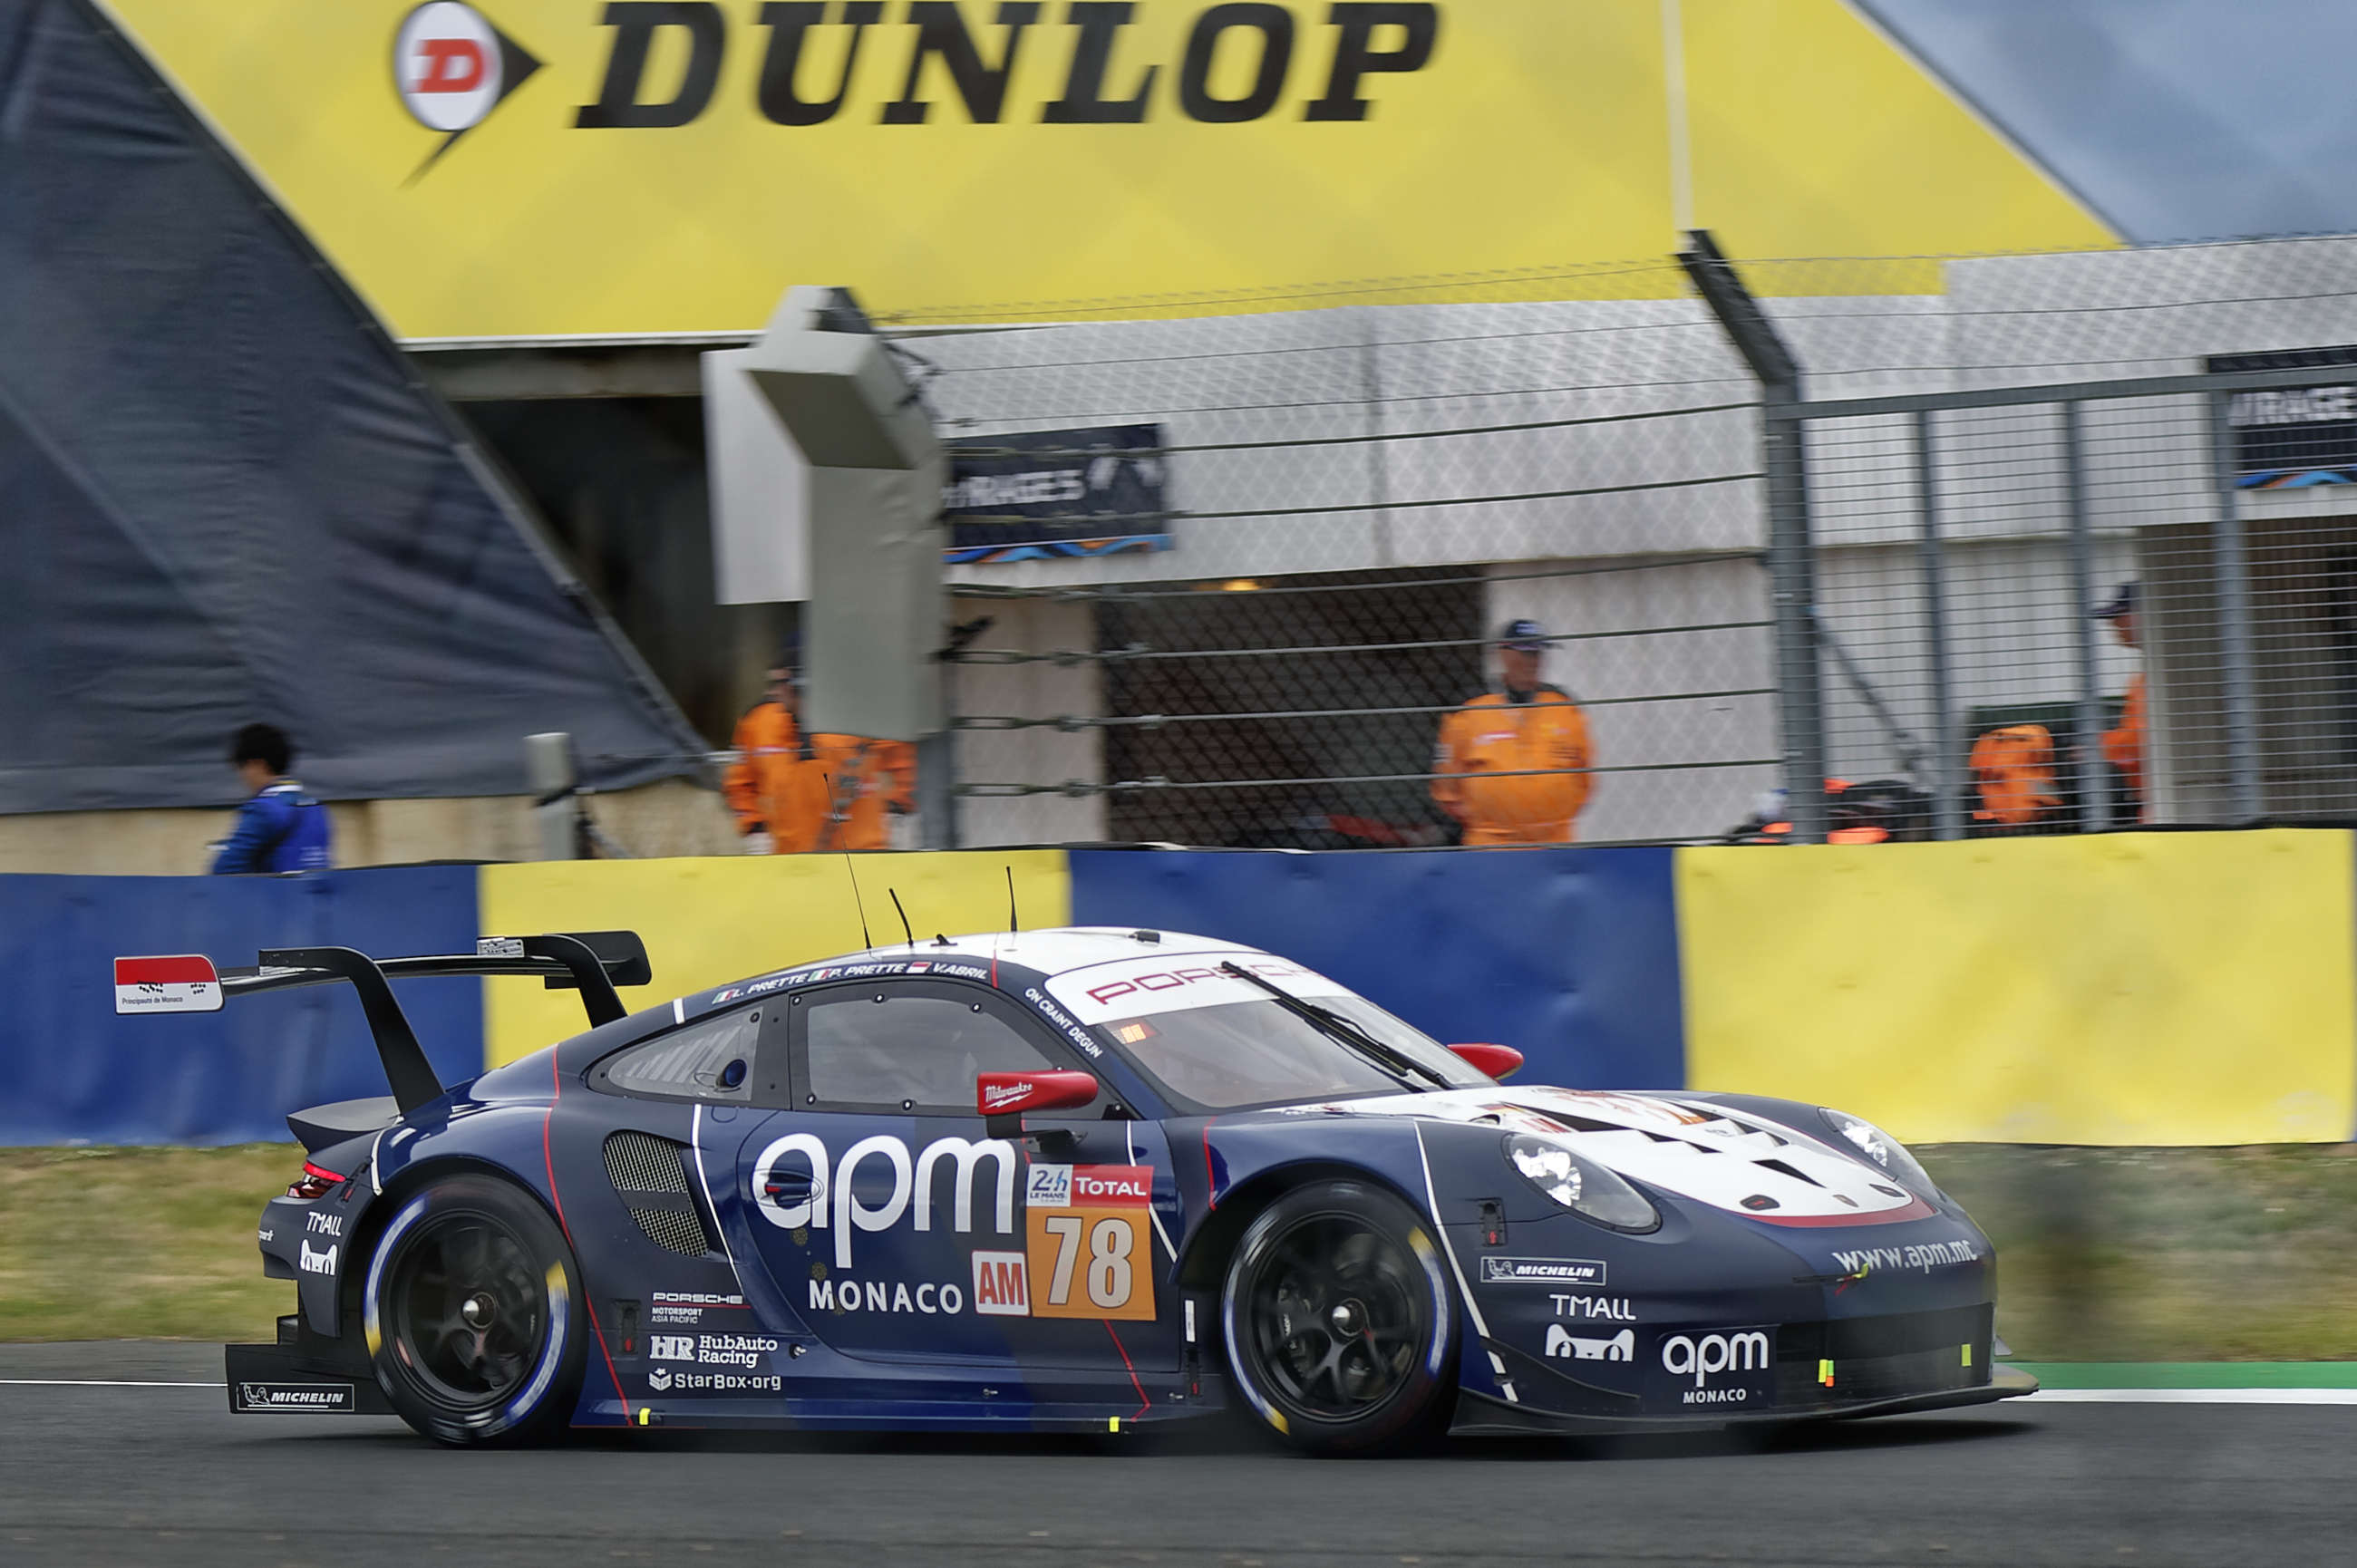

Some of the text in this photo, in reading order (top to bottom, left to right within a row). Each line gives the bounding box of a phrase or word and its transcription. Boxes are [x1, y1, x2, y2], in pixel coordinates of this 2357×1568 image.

[411, 0, 1440, 129] D DUNLOP
[844, 963, 907, 976] PRETTE
[933, 963, 986, 980] V.ABRIL
[747, 973, 809, 994] PRETTE
[1025, 988, 1103, 1059] ON CRAINT DEGUN
[985, 1081, 1033, 1102] Milwaukee
[752, 1132, 1017, 1268] apm
[306, 1211, 342, 1236] TMALL
[1044, 1216, 1134, 1309] 78
[1831, 1239, 1978, 1274] www.apm.mc
[1515, 1264, 1596, 1278] MICHELIN
[978, 1261, 1023, 1305] AM
[652, 1292, 743, 1304] PORSCHE
[809, 1279, 964, 1314] MONACO
[1549, 1293, 1636, 1321] TMALL
[652, 1307, 703, 1316] MOTORSPORT
[670, 1316, 698, 1324] PACIFIC
[699, 1334, 778, 1351] HubAuto
[698, 1350, 759, 1369] Racing
[1662, 1331, 1769, 1388] apm
[271, 1391, 344, 1404] MICHELIN
[1683, 1389, 1747, 1404] MONACO
